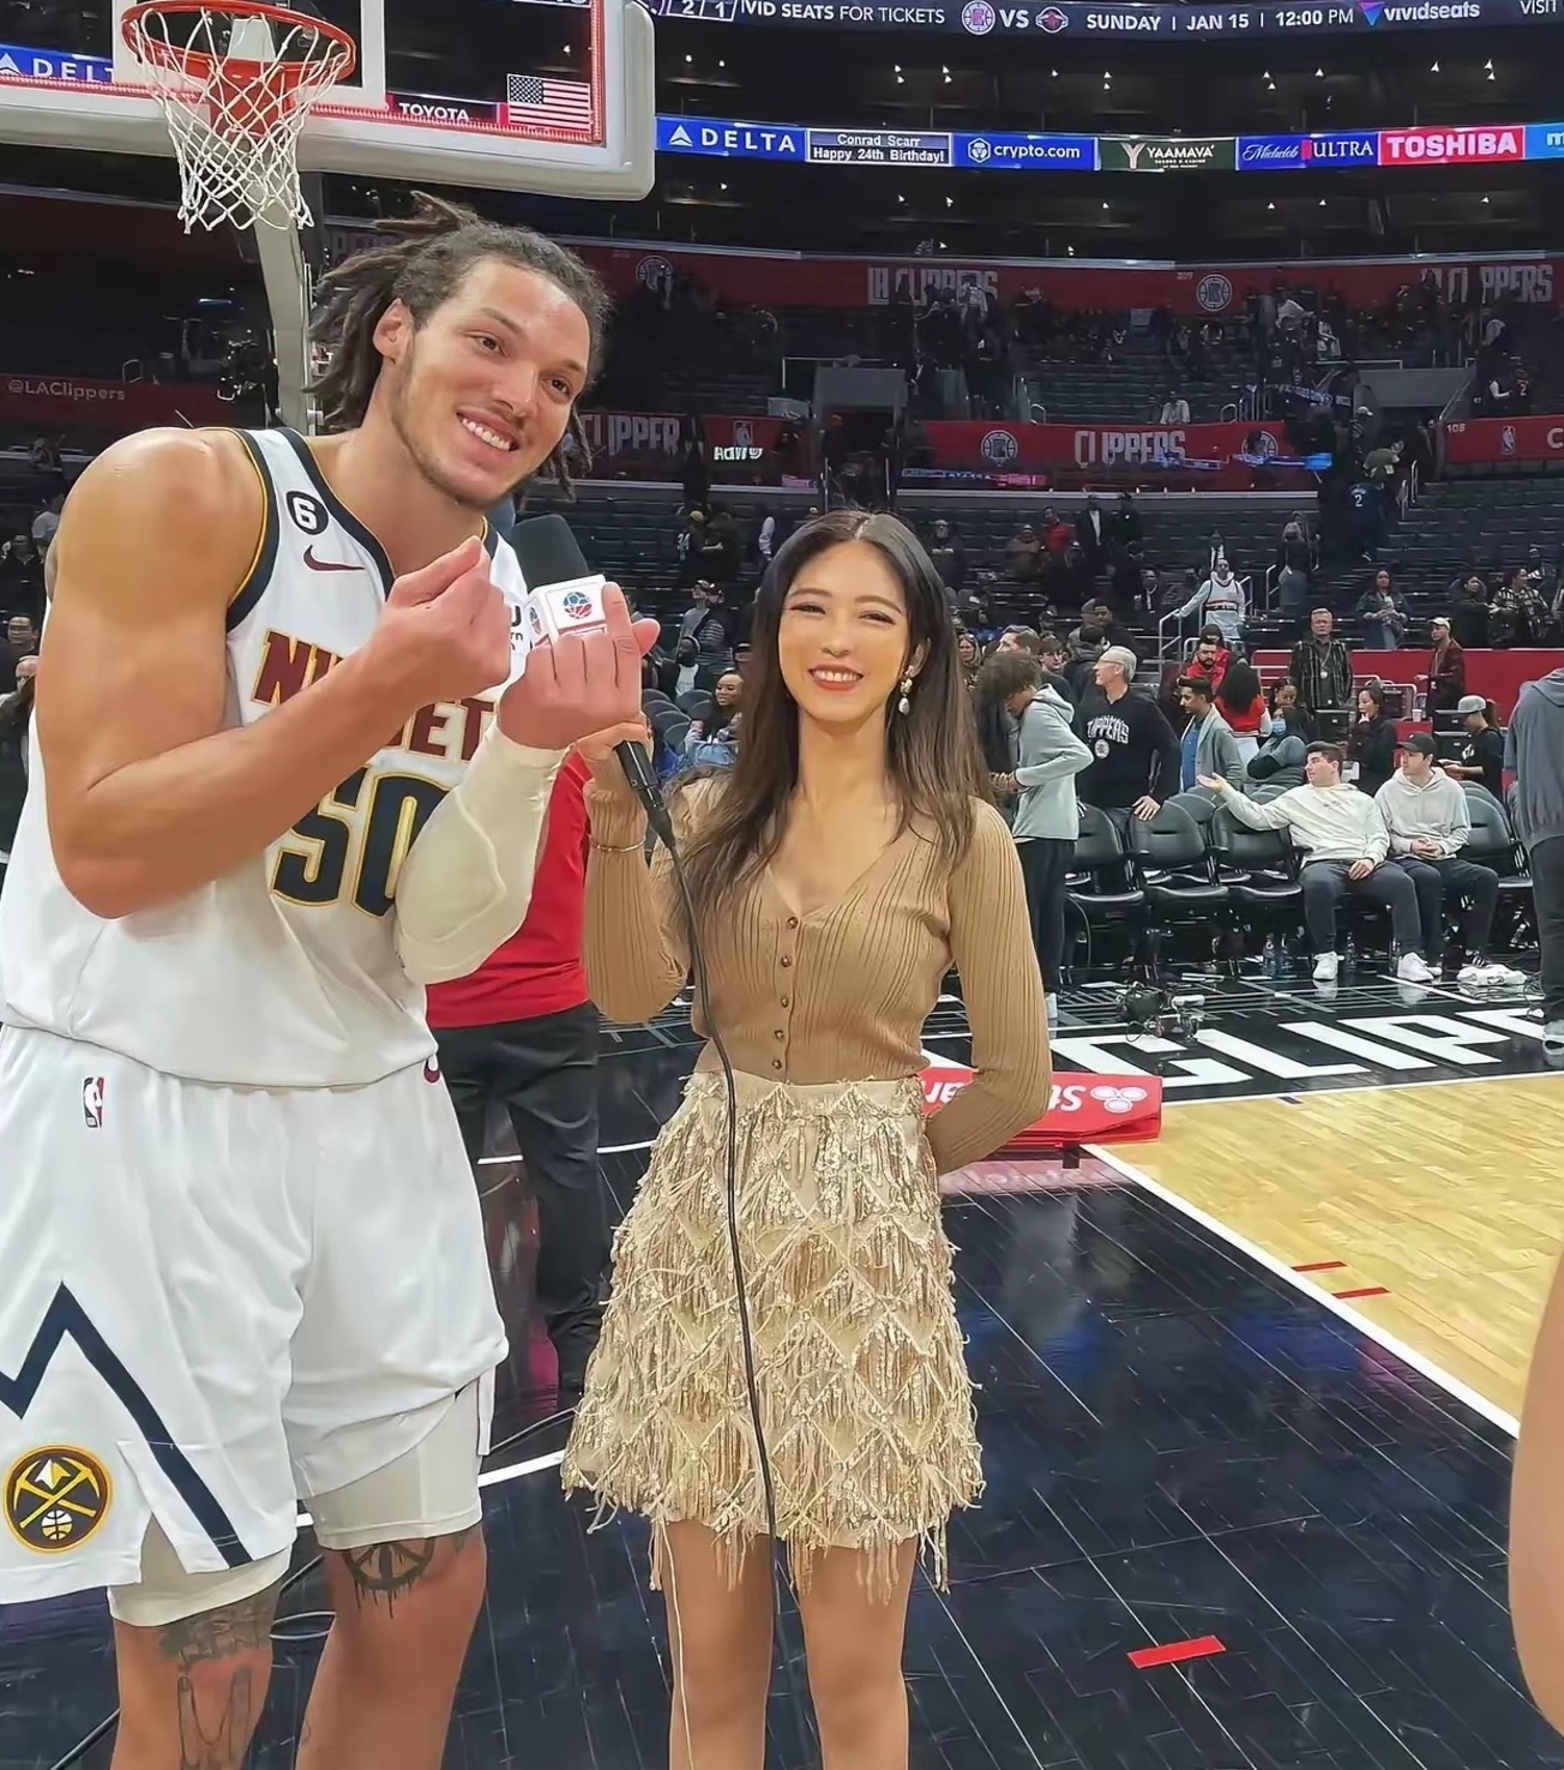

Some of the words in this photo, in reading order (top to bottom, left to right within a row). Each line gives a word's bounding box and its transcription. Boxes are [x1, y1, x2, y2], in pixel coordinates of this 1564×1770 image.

[781, 5, 834, 20] SEATS
[840, 6, 874, 22] FOR
[878, 8, 945, 24] TICKETS
[999, 9, 1030, 28] VS
[1086, 13, 1162, 31] SUNDAY
[1186, 15, 1223, 31] JAN
[1228, 14, 1250, 29] 15
[1275, 10, 1323, 27] 12:00
[1328, 8, 1354, 24] PM
[1384, 2, 1481, 21] vividseats
[399, 102, 470, 122] TOYOTA
[701, 127, 796, 153] DELTA
[837, 133, 881, 145] Conrad
[887, 135, 922, 147] Scarr
[1313, 140, 1374, 158] ULTRA
[1386, 132, 1517, 158] TOSHIBA
[813, 147, 852, 161] Happy
[858, 148, 884, 160] 24th
[890, 149, 945, 164] Birthday!
[993, 144, 1081, 159] crypto.com
[8, 379, 125, 401] @LAClippers
[294, 496, 317, 531] 6
[270, 766, 452, 919] 50
